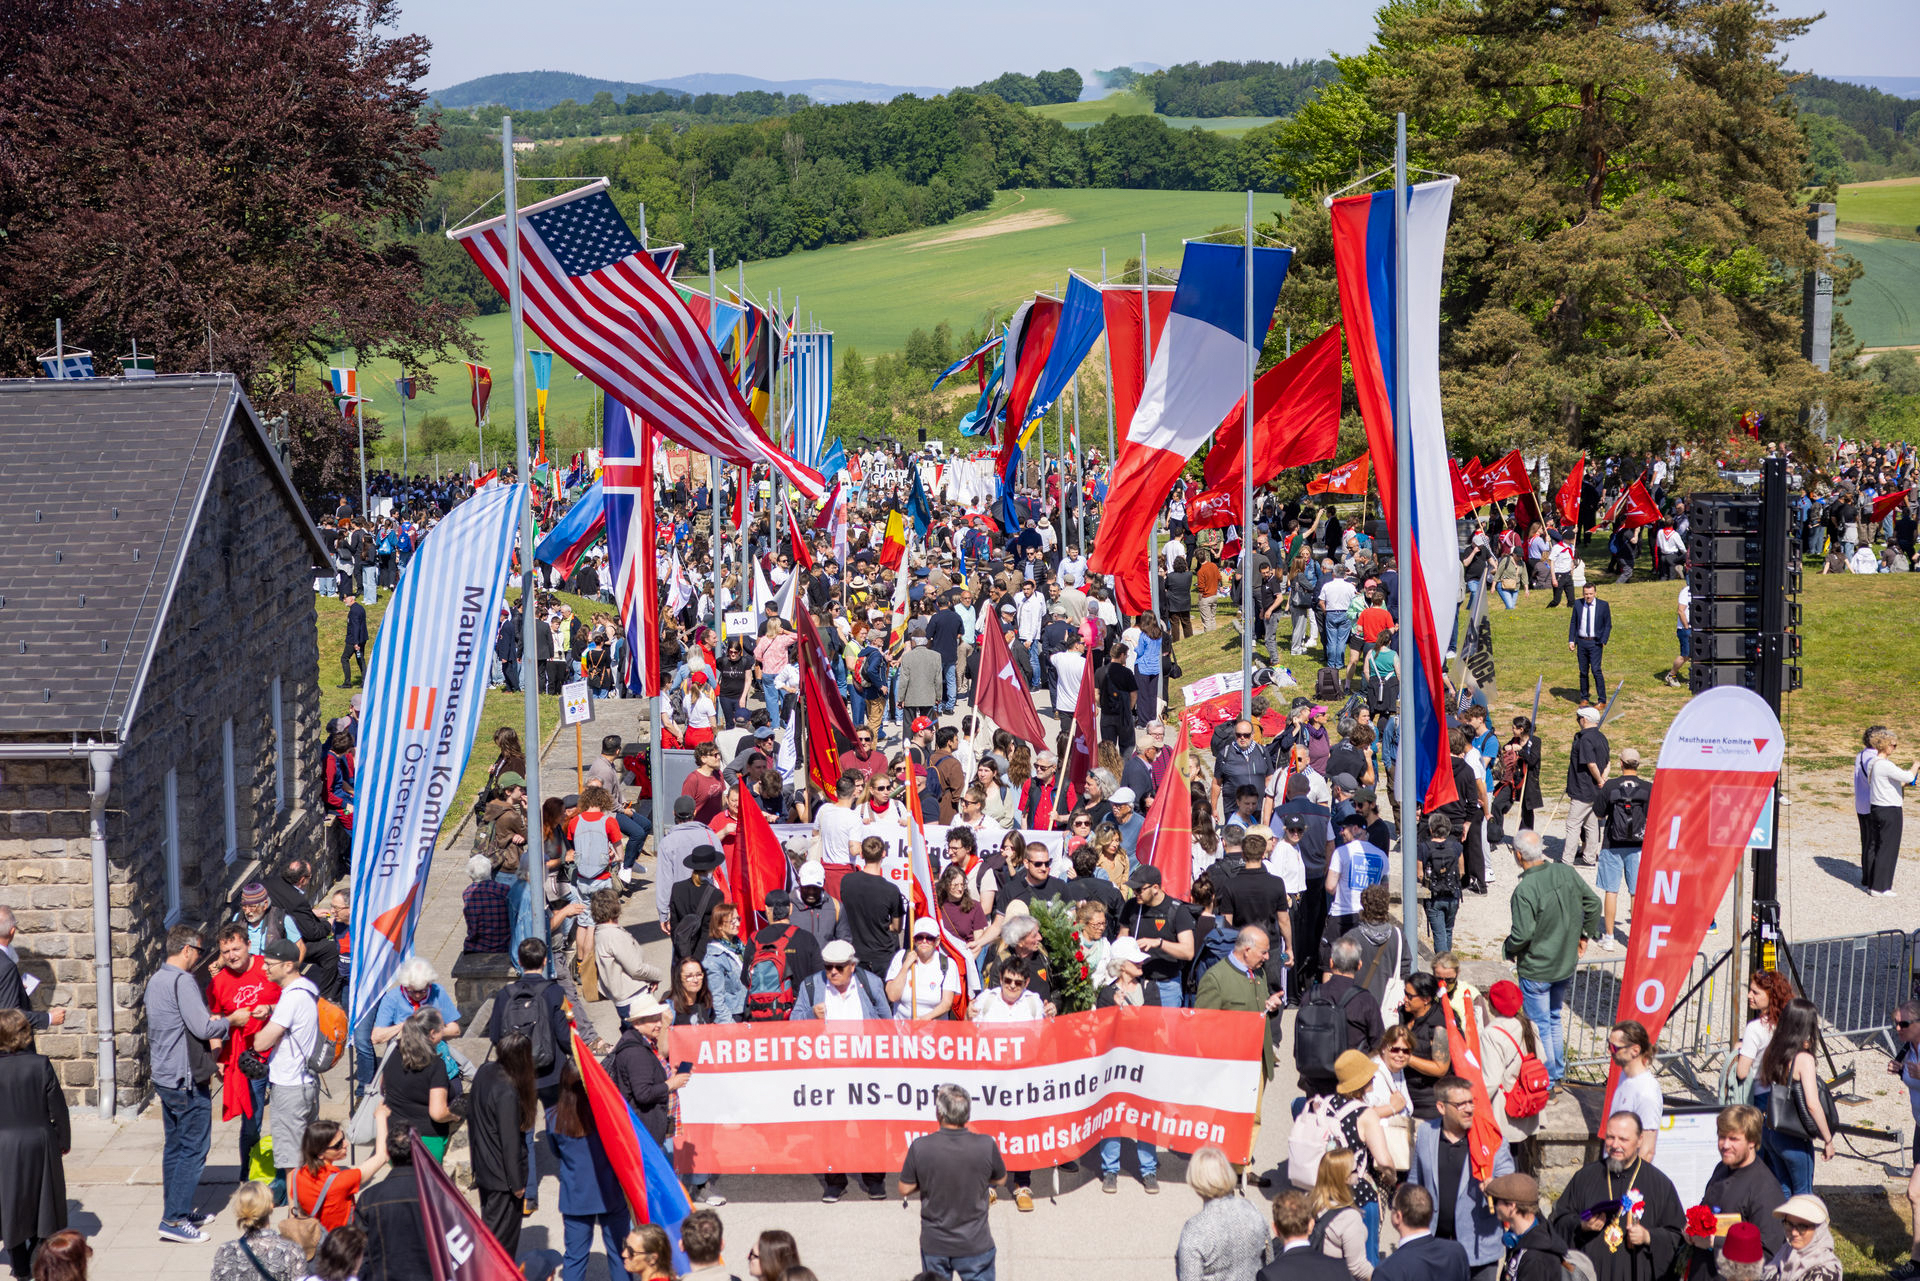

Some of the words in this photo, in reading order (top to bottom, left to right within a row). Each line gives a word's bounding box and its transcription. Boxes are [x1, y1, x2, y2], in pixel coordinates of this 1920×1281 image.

[733, 617, 749, 625] A-D
[435, 585, 485, 756] Mauthausen
[1678, 736, 1721, 745] Mauthausen
[1722, 737, 1752, 746] Komitee
[379, 743, 426, 878] Österreich
[1636, 815, 1681, 1014] INFO
[697, 1035, 1026, 1064] ARBEITSGEMEINSCHAFT
[793, 1084, 836, 1107] der
[848, 1073, 1099, 1111] NS-Opf-Verbände
[1104, 1063, 1145, 1084] und
